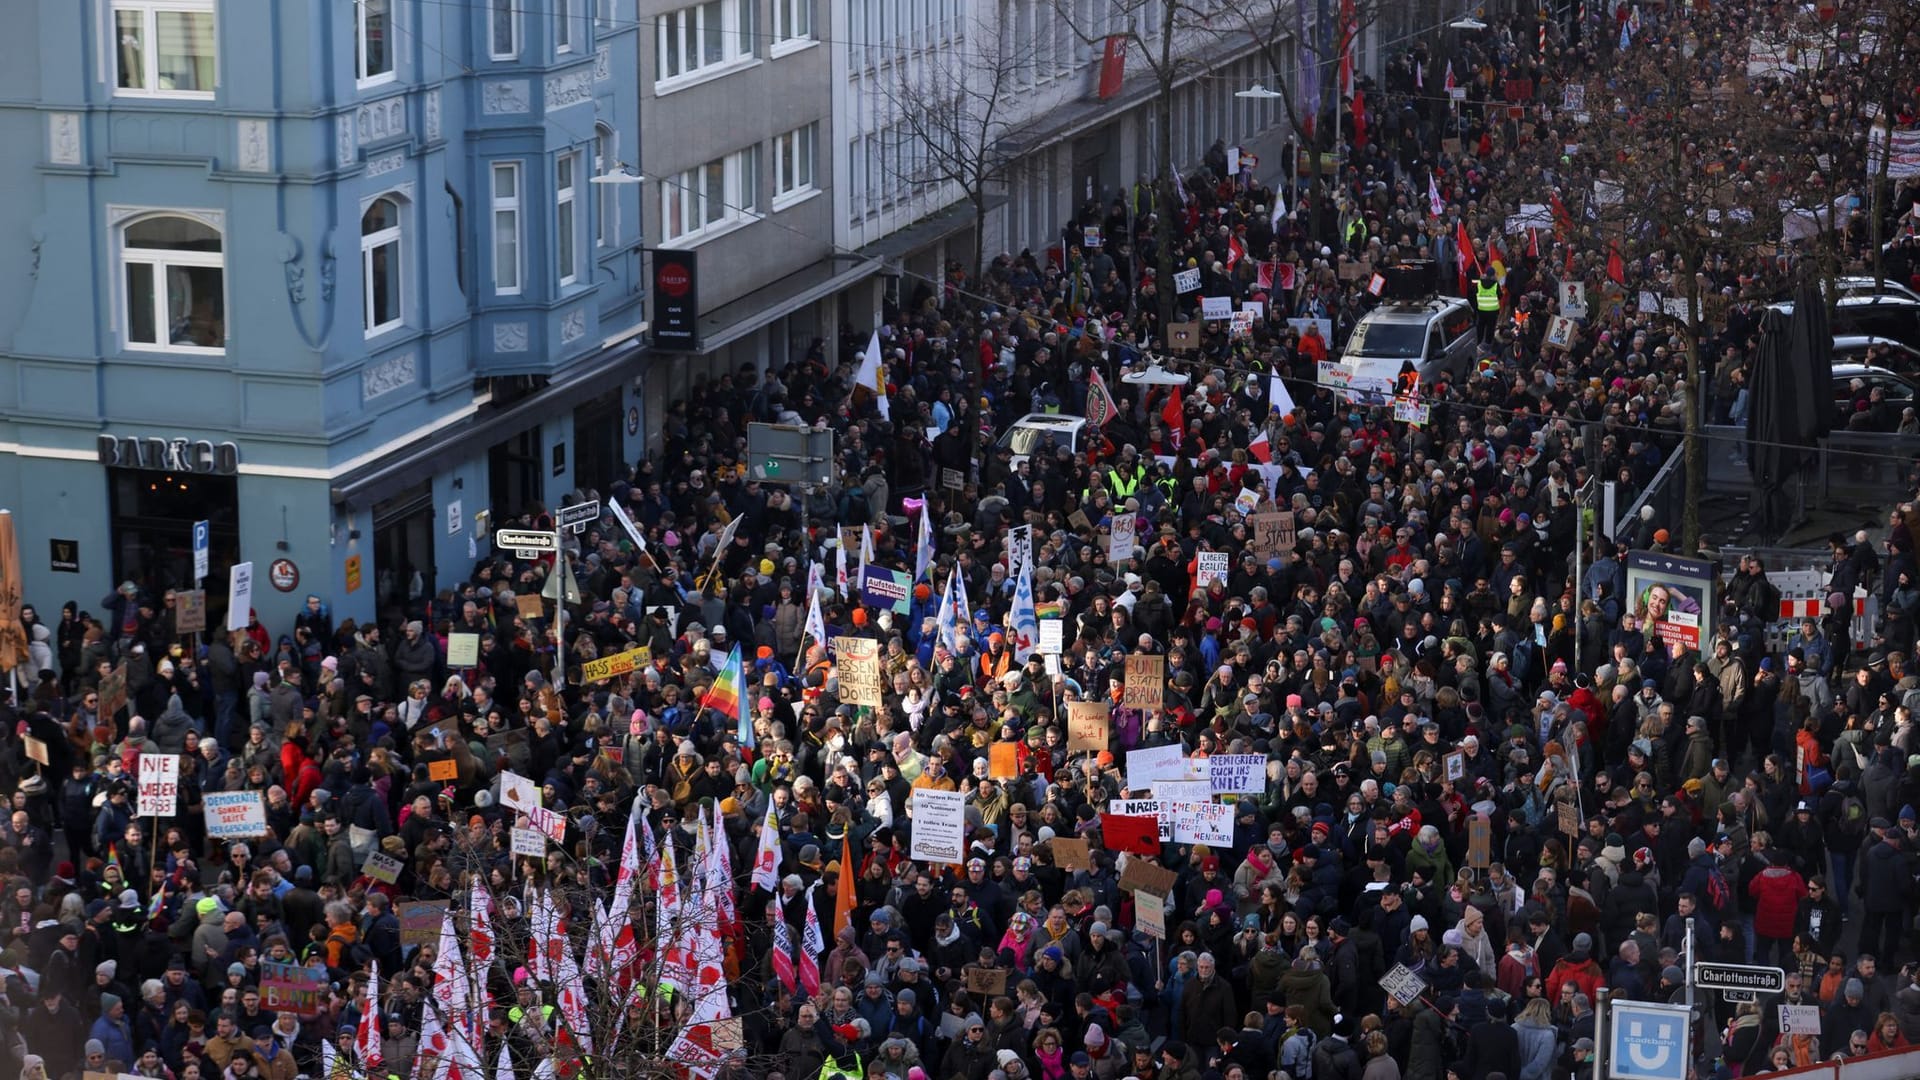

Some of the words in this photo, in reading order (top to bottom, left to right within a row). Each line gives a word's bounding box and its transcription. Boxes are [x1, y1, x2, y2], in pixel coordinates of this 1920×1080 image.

[196, 525, 206, 549] P
[502, 534, 552, 547] Charlottenstraße
[1265, 530, 1294, 546] STATT
[868, 578, 908, 597] Aufstehen
[837, 641, 870, 655] NAZIS
[585, 660, 609, 680] HASS
[838, 659, 877, 674] ESSEN
[1126, 658, 1161, 675] BUNT
[838, 672, 880, 688] HEIMLICH
[1129, 675, 1161, 686] STATT
[1126, 687, 1162, 704] BRAUN
[143, 757, 171, 771] NIE
[1210, 754, 1265, 767] REMIGRIERT
[1210, 766, 1234, 777] EUCH
[1236, 765, 1250, 775] INS
[138, 783, 177, 797] WIEDER
[141, 799, 171, 812] 1933
[207, 792, 259, 807] DEMOKRATIE
[929, 804, 957, 812] Nationen
[1125, 801, 1159, 815] NAZIS
[1194, 832, 1232, 842] MENSCHEN
[1703, 969, 1776, 987] Charlottenstraße
[1623, 1036, 1677, 1047] stadtbahn
